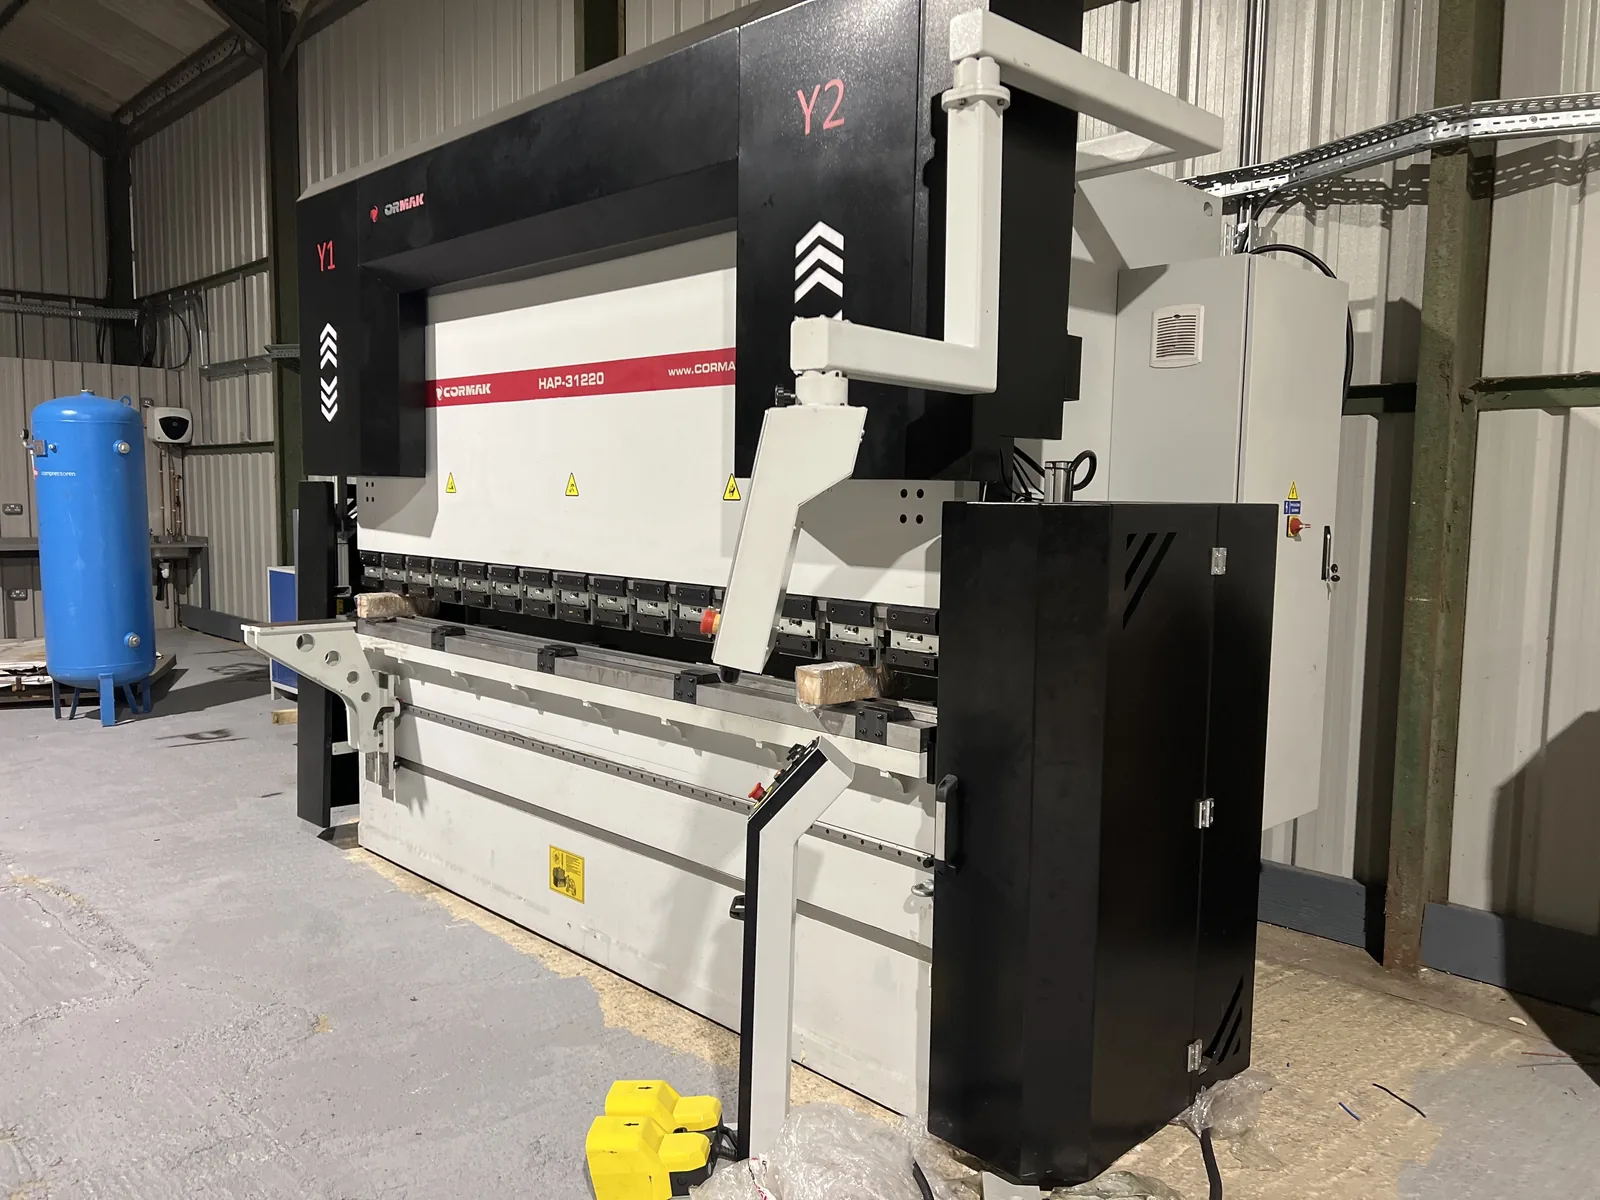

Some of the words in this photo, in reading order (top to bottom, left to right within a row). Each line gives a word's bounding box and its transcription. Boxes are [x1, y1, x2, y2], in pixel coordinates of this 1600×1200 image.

[796, 78, 845, 135] Y2
[316, 240, 335, 271] Y1
[443, 383, 492, 398] CORMAK
[538, 371, 604, 390] HAP-31220
